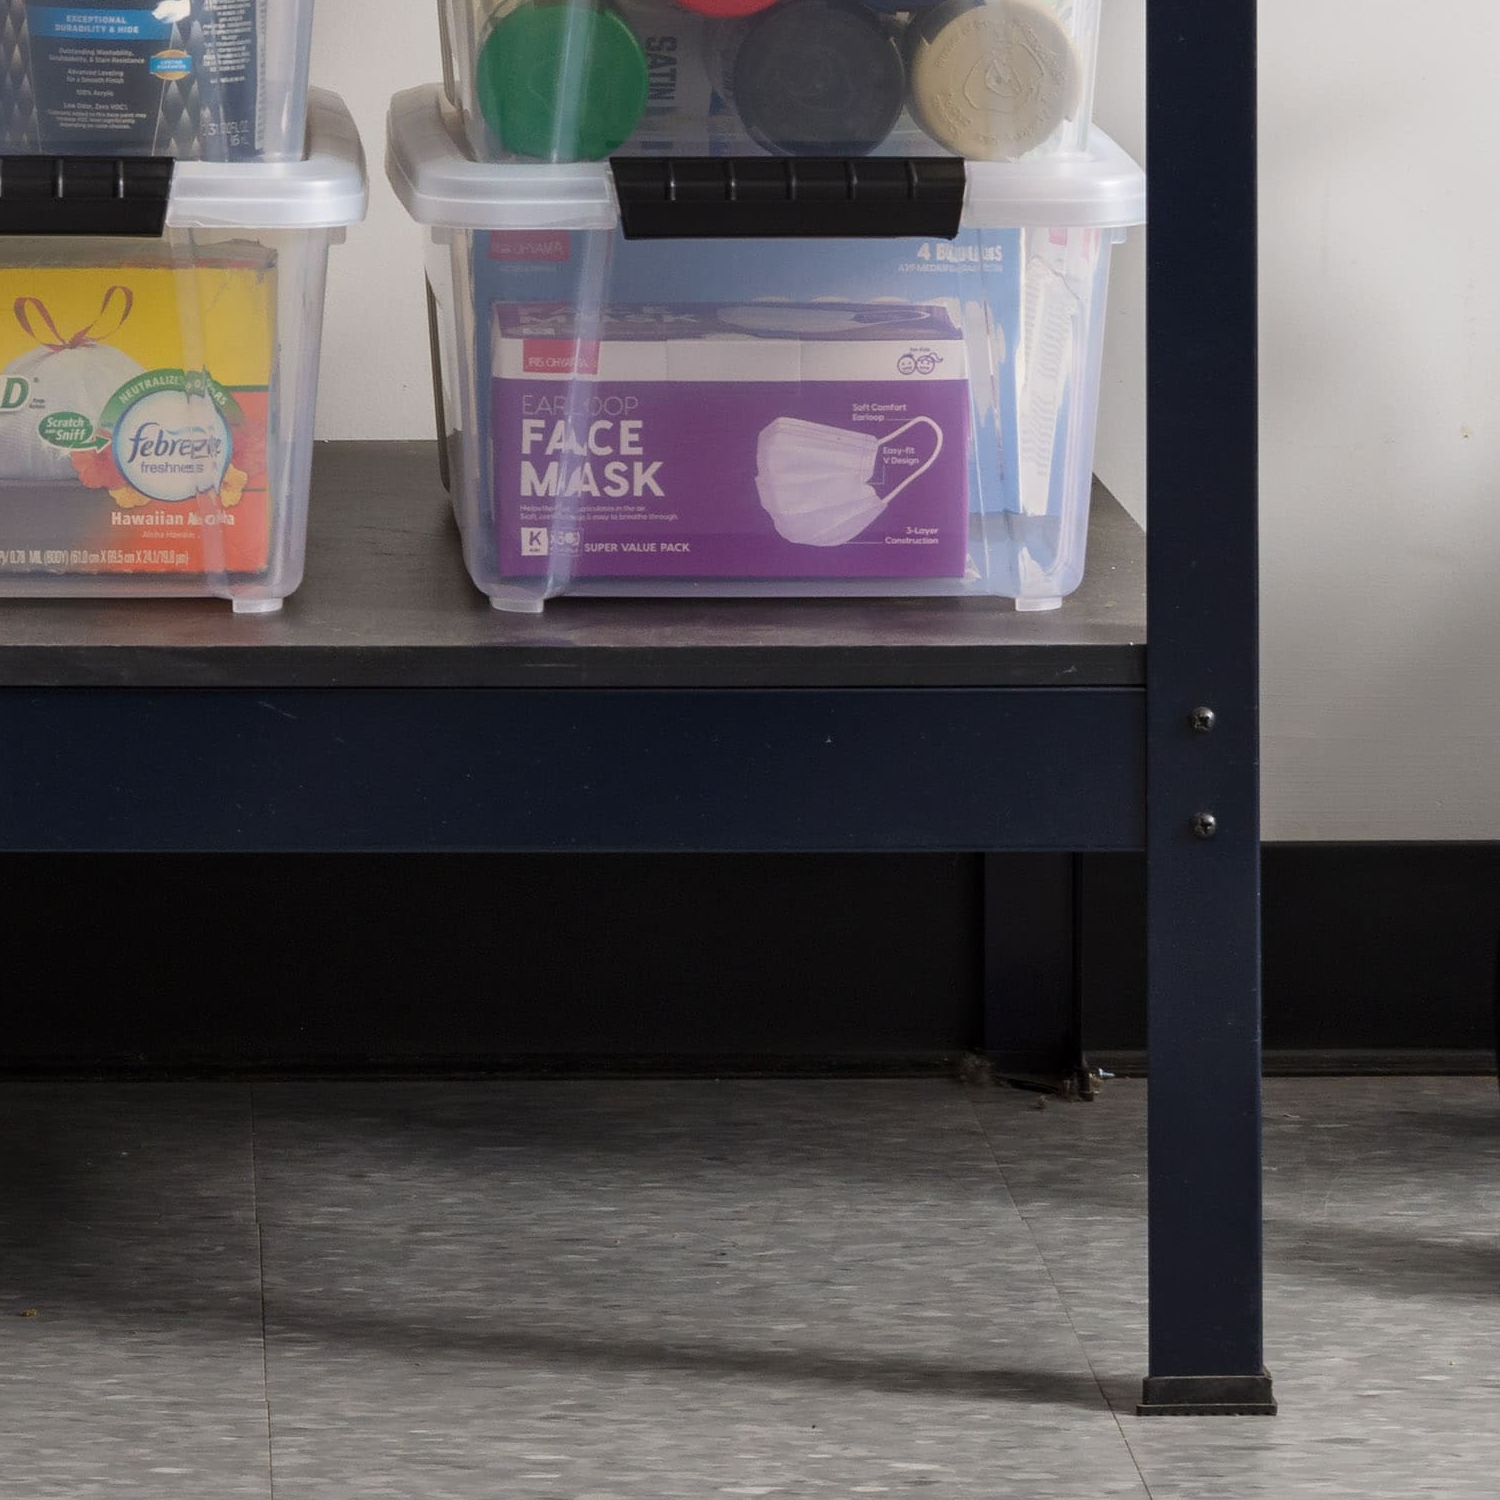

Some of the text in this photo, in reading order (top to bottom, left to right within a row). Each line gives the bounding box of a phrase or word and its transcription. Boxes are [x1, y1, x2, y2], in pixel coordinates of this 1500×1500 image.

[66, 15, 126, 24] EXCEPTIONAL
[54, 24, 106, 33] DURABILITY
[117, 25, 140, 33] HIDE
[645, 36, 677, 100] SATIN
[917, 242, 931, 260] 4
[522, 395, 638, 416] EAROOP
[852, 403, 907, 412] Soft Comfort
[47, 417, 85, 428] Scratch
[852, 413, 885, 422] Earloop
[56, 428, 85, 441] Sniff
[521, 419, 643, 456] FACE
[883, 446, 915, 456] Easy-fit
[883, 457, 919, 467] V Design
[520, 461, 666, 498] MASK
[111, 511, 183, 526] Hawaiian
[619, 513, 648, 521] breathe
[906, 526, 939, 536] 3-Layer
[529, 531, 542, 546] K
[884, 536, 939, 545] Construction
[584, 543, 691, 553] SUPER VALUE PACK
